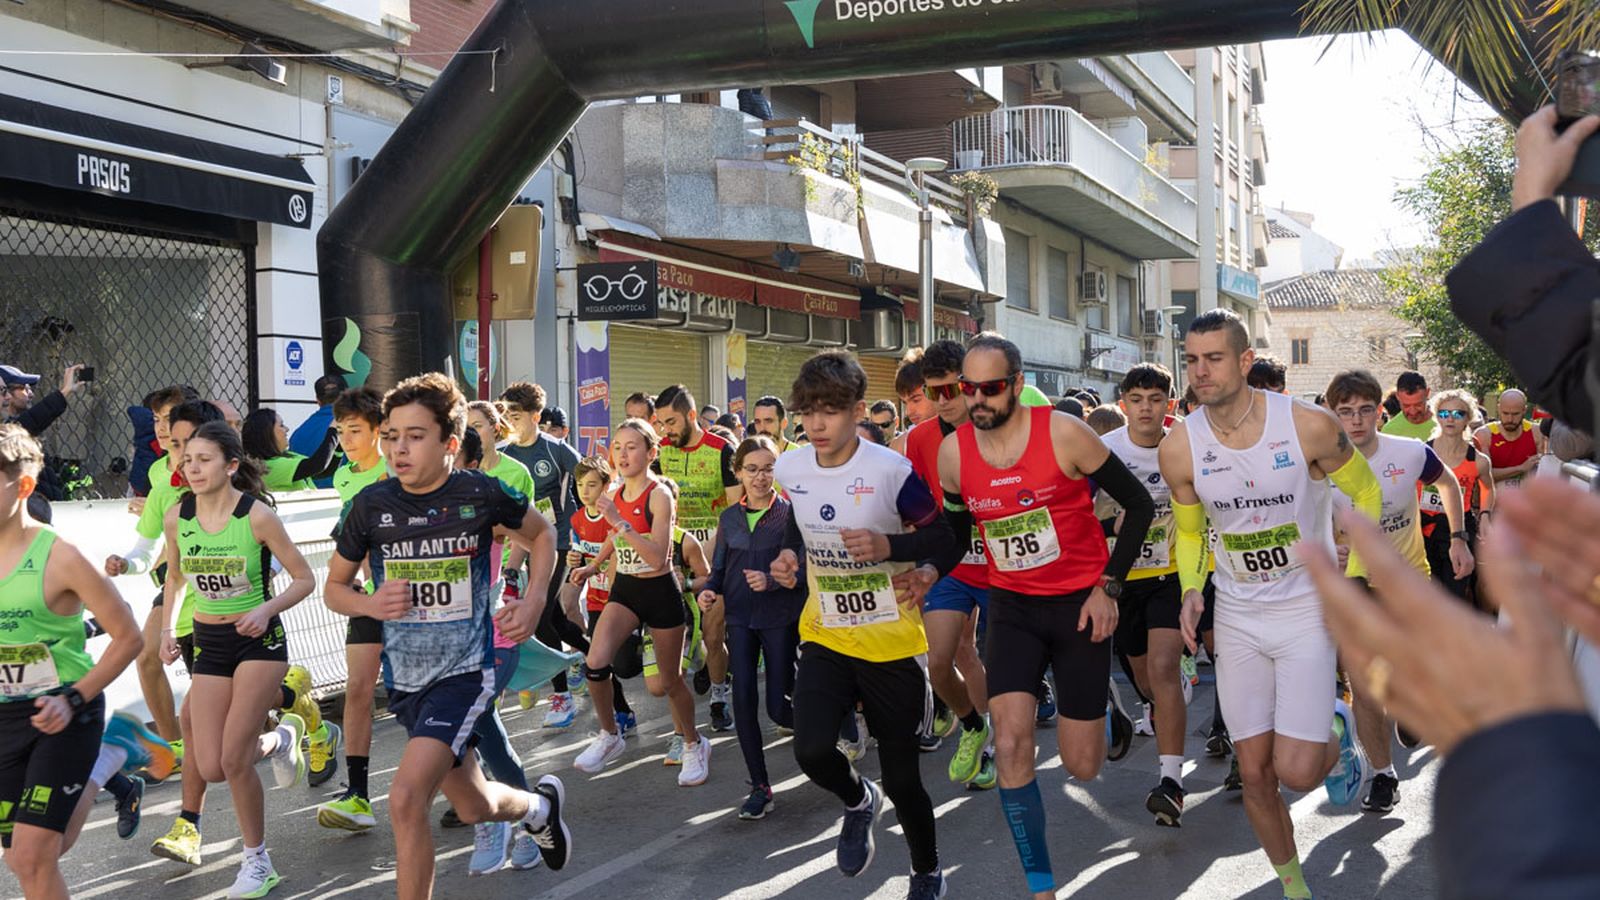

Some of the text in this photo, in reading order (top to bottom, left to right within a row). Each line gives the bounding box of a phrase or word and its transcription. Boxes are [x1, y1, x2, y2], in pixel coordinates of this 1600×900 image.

[835, 0, 944, 22] Deportes
[77, 153, 130, 193] PASOS
[657, 265, 694, 286] sa Paco
[658, 285, 691, 313] asa
[579, 426, 609, 459] 75
[1213, 493, 1295, 510] Da Ernesto
[1383, 518, 1411, 533] TOLES
[380, 531, 480, 559] SAN ANTÓN
[807, 547, 833, 558] ANTA
[998, 532, 1040, 559] 736
[816, 558, 886, 571] APÓSTOLE
[1243, 546, 1288, 572] 680
[196, 575, 232, 592] 664
[835, 591, 877, 614] 808
